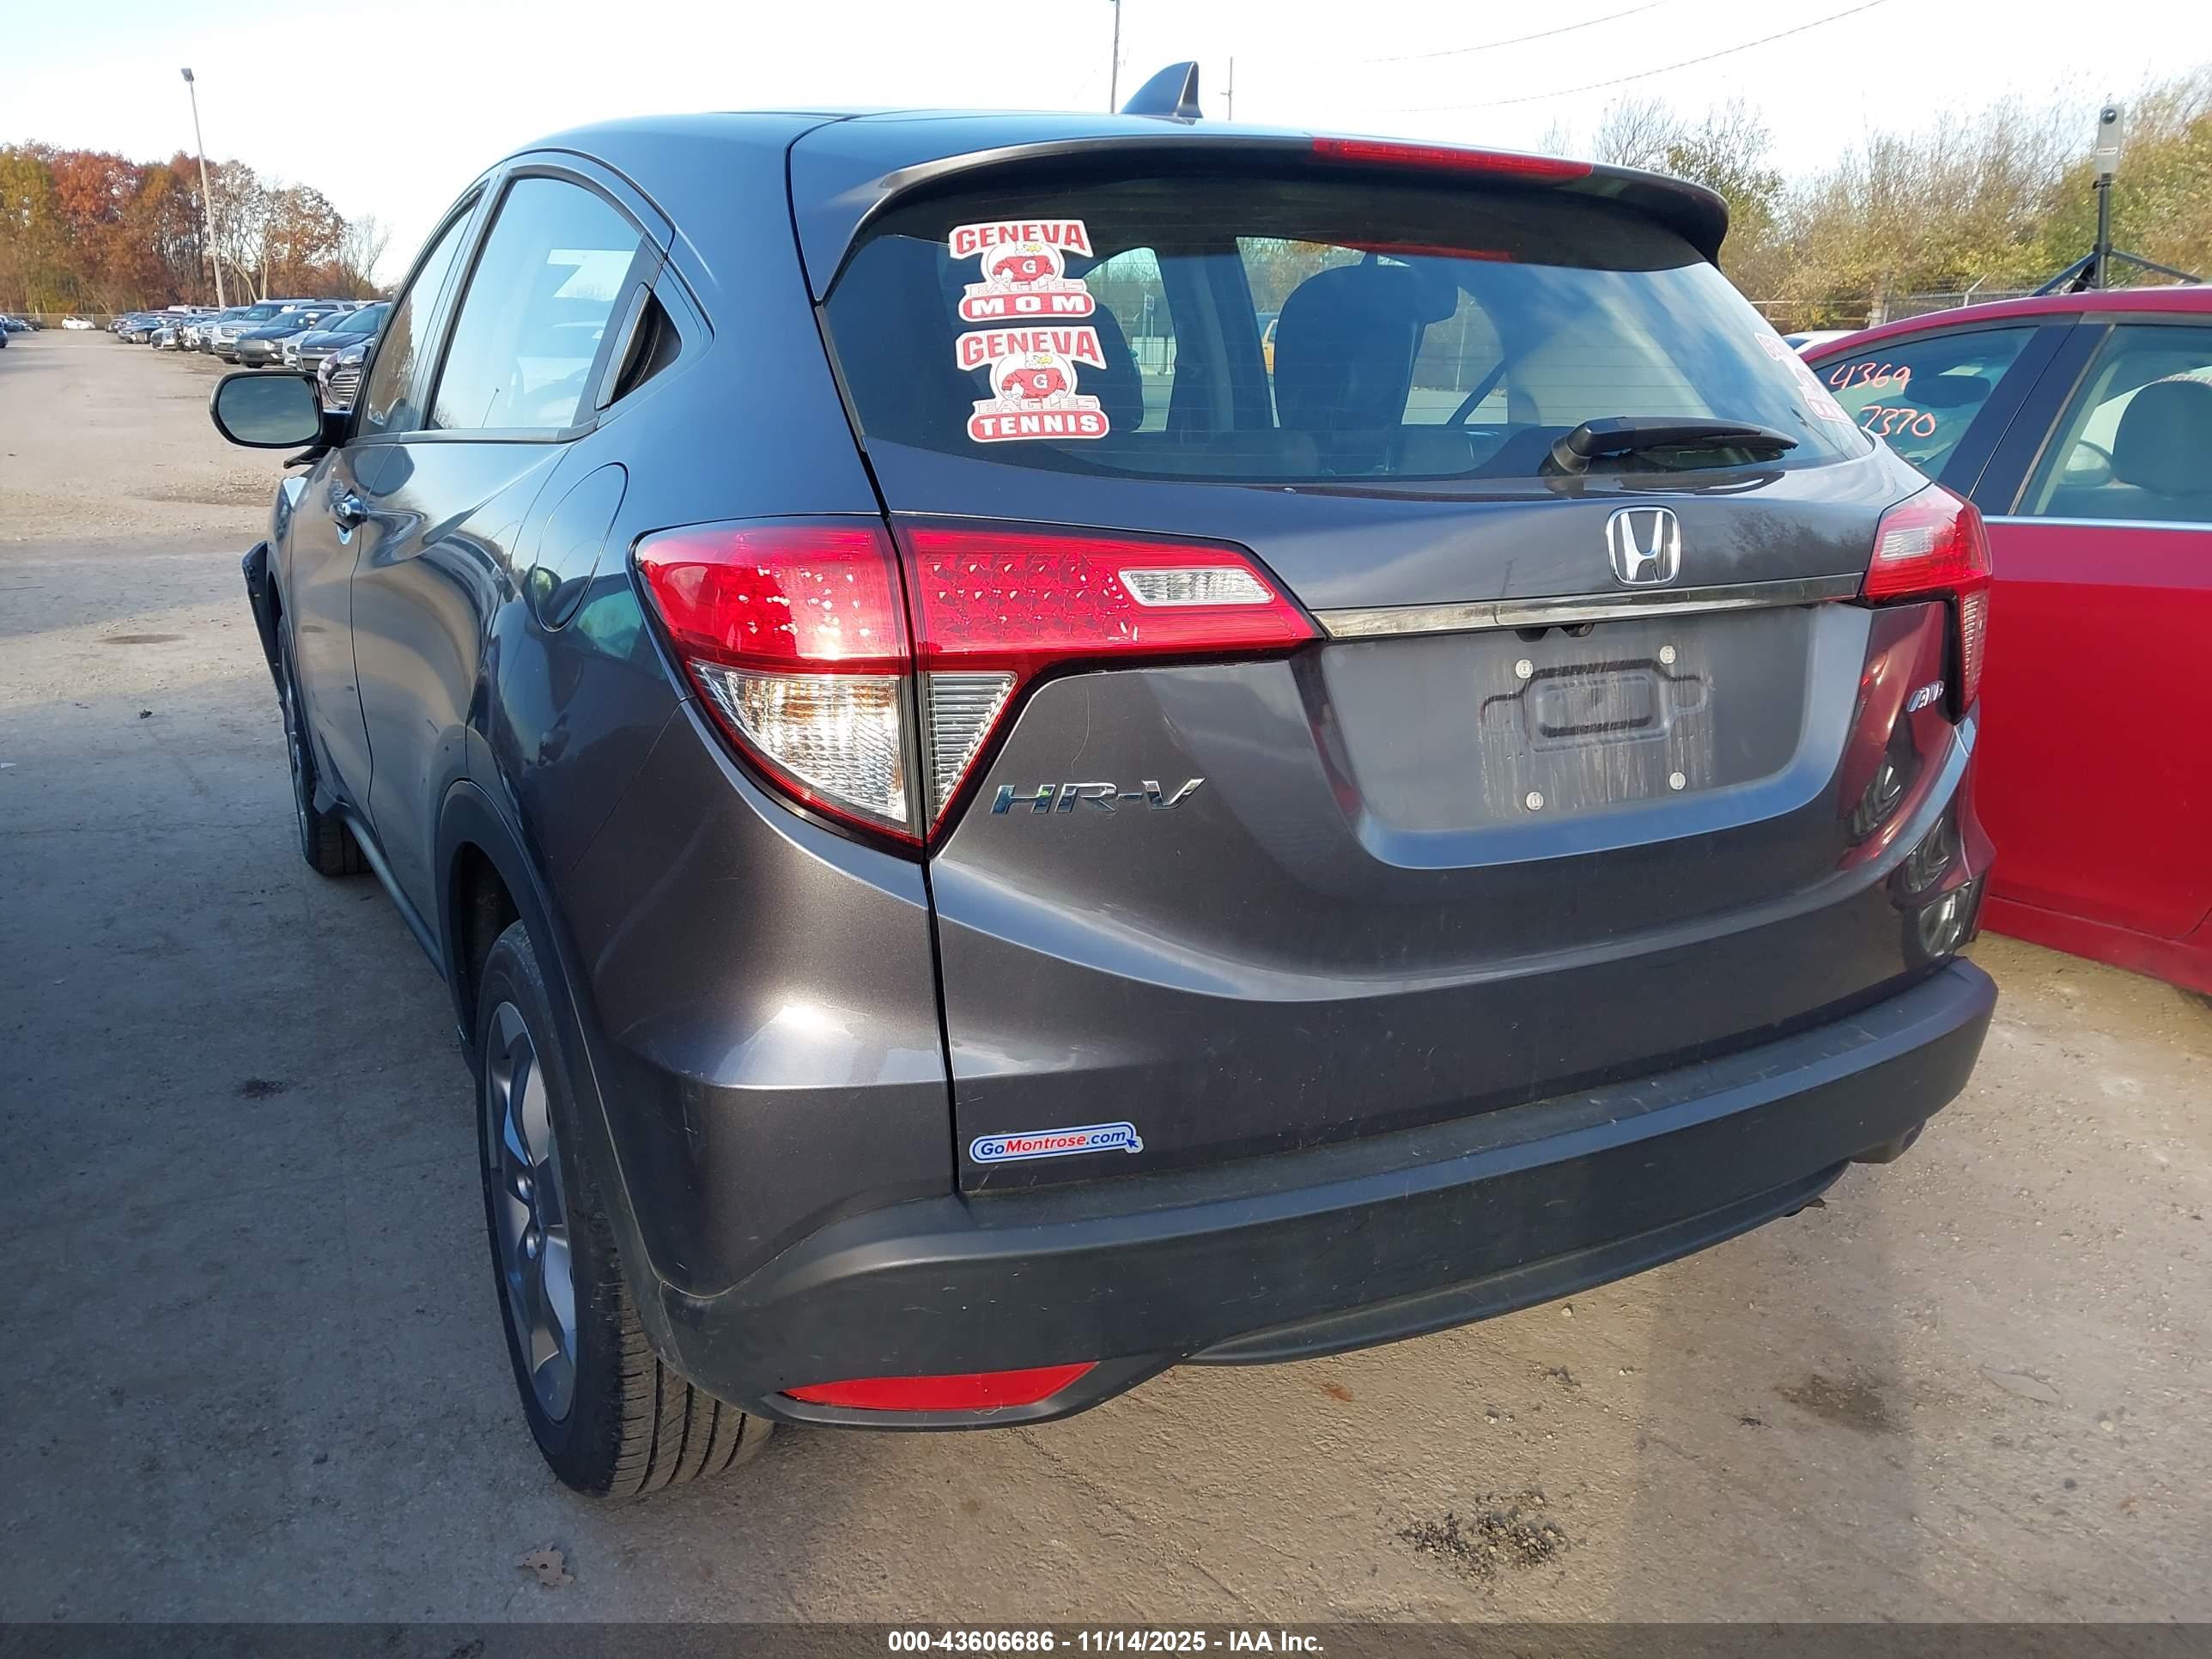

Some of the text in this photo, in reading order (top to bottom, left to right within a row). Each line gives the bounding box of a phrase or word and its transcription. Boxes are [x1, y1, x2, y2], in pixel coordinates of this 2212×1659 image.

[956, 224, 1086, 254] GENEVA
[1022, 260, 1036, 274] G
[970, 281, 1085, 296] EAGLES
[971, 295, 1086, 316] MOM
[963, 331, 1100, 366] GENEVA
[1033, 374, 1048, 389] G
[1829, 362, 1911, 390] 4369
[979, 398, 1098, 414] EAGLES
[980, 415, 1100, 435] TENNIS
[1859, 405, 1936, 437] 7370
[990, 777, 1206, 814] HR-V
[981, 1131, 1127, 1156] GoMontrose.com
